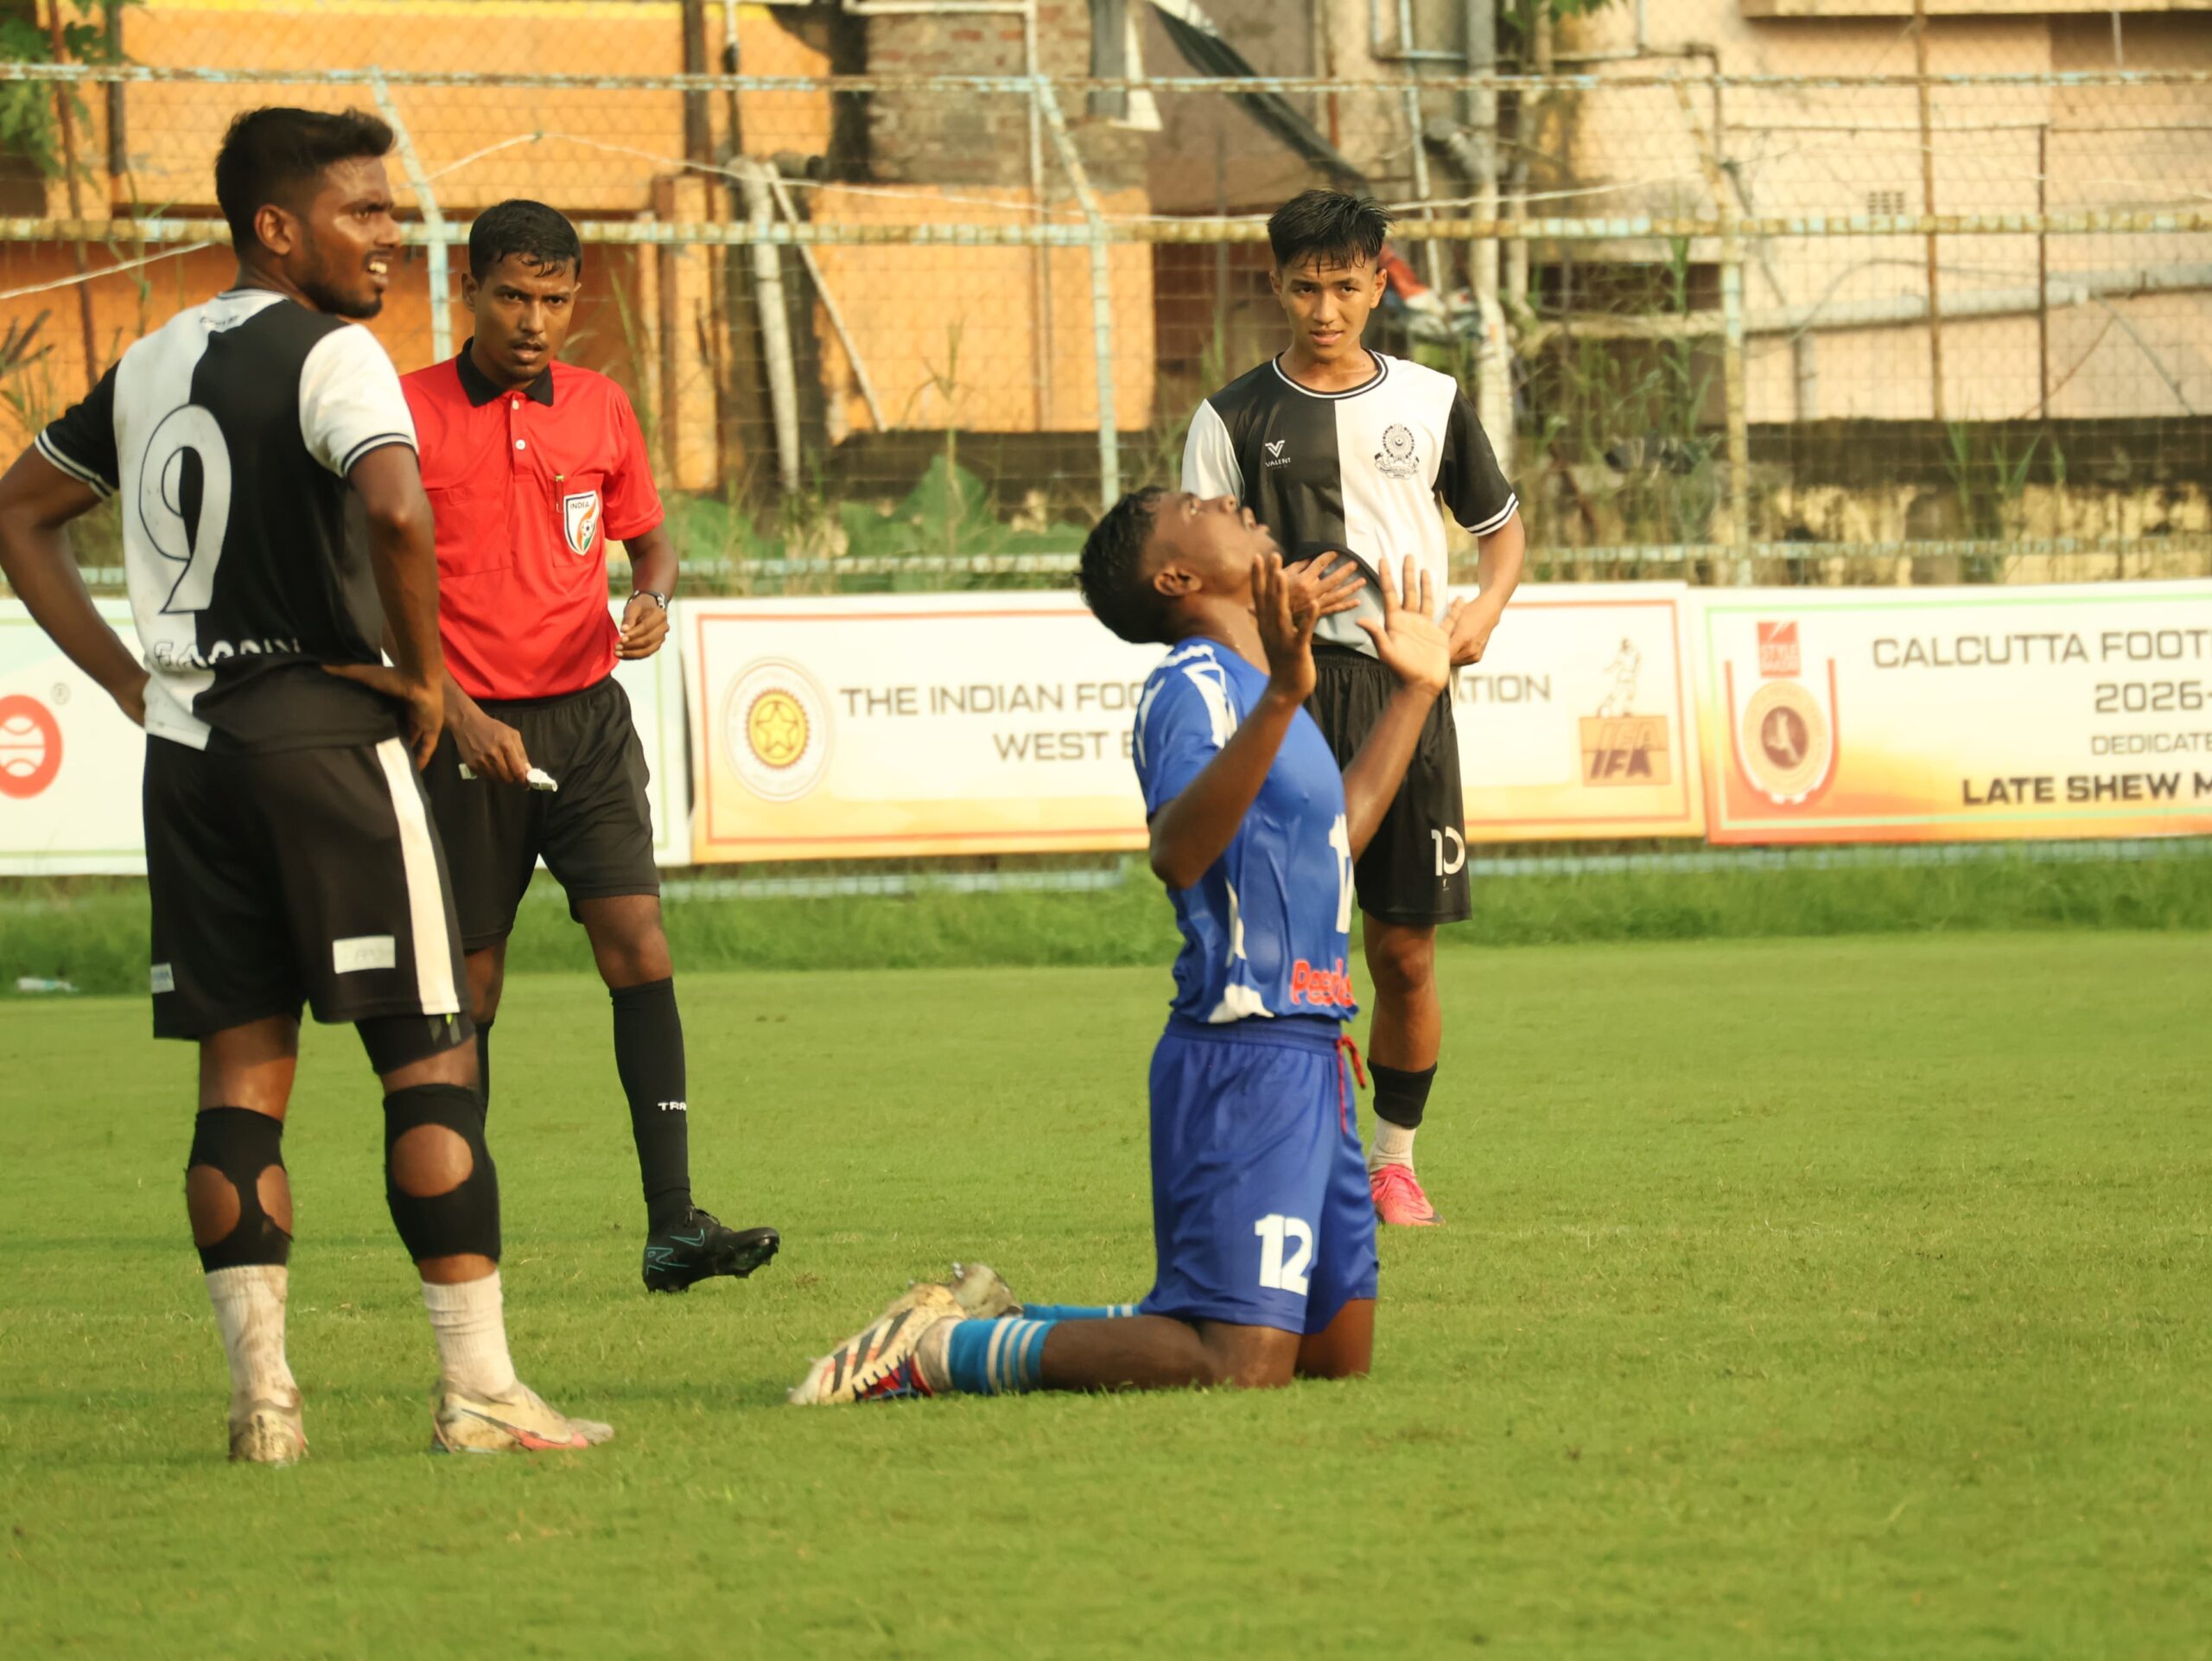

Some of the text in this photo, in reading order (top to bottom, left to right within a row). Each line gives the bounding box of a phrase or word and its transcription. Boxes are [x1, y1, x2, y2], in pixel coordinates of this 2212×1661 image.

[1264, 457, 1291, 468] VALENT
[138, 403, 232, 614] 9
[569, 501, 590, 510] INDIA
[1873, 629, 2209, 668] CALCUTTA FOOT
[841, 688, 919, 717] THE
[931, 683, 1064, 714] INDIAN
[1457, 674, 1551, 703] TION
[993, 730, 1109, 761] WEST
[1963, 778, 2055, 805] LATE
[2066, 773, 2181, 803] SHEW
[1431, 825, 1465, 876] 10
[1255, 1214, 1313, 1295] 12
